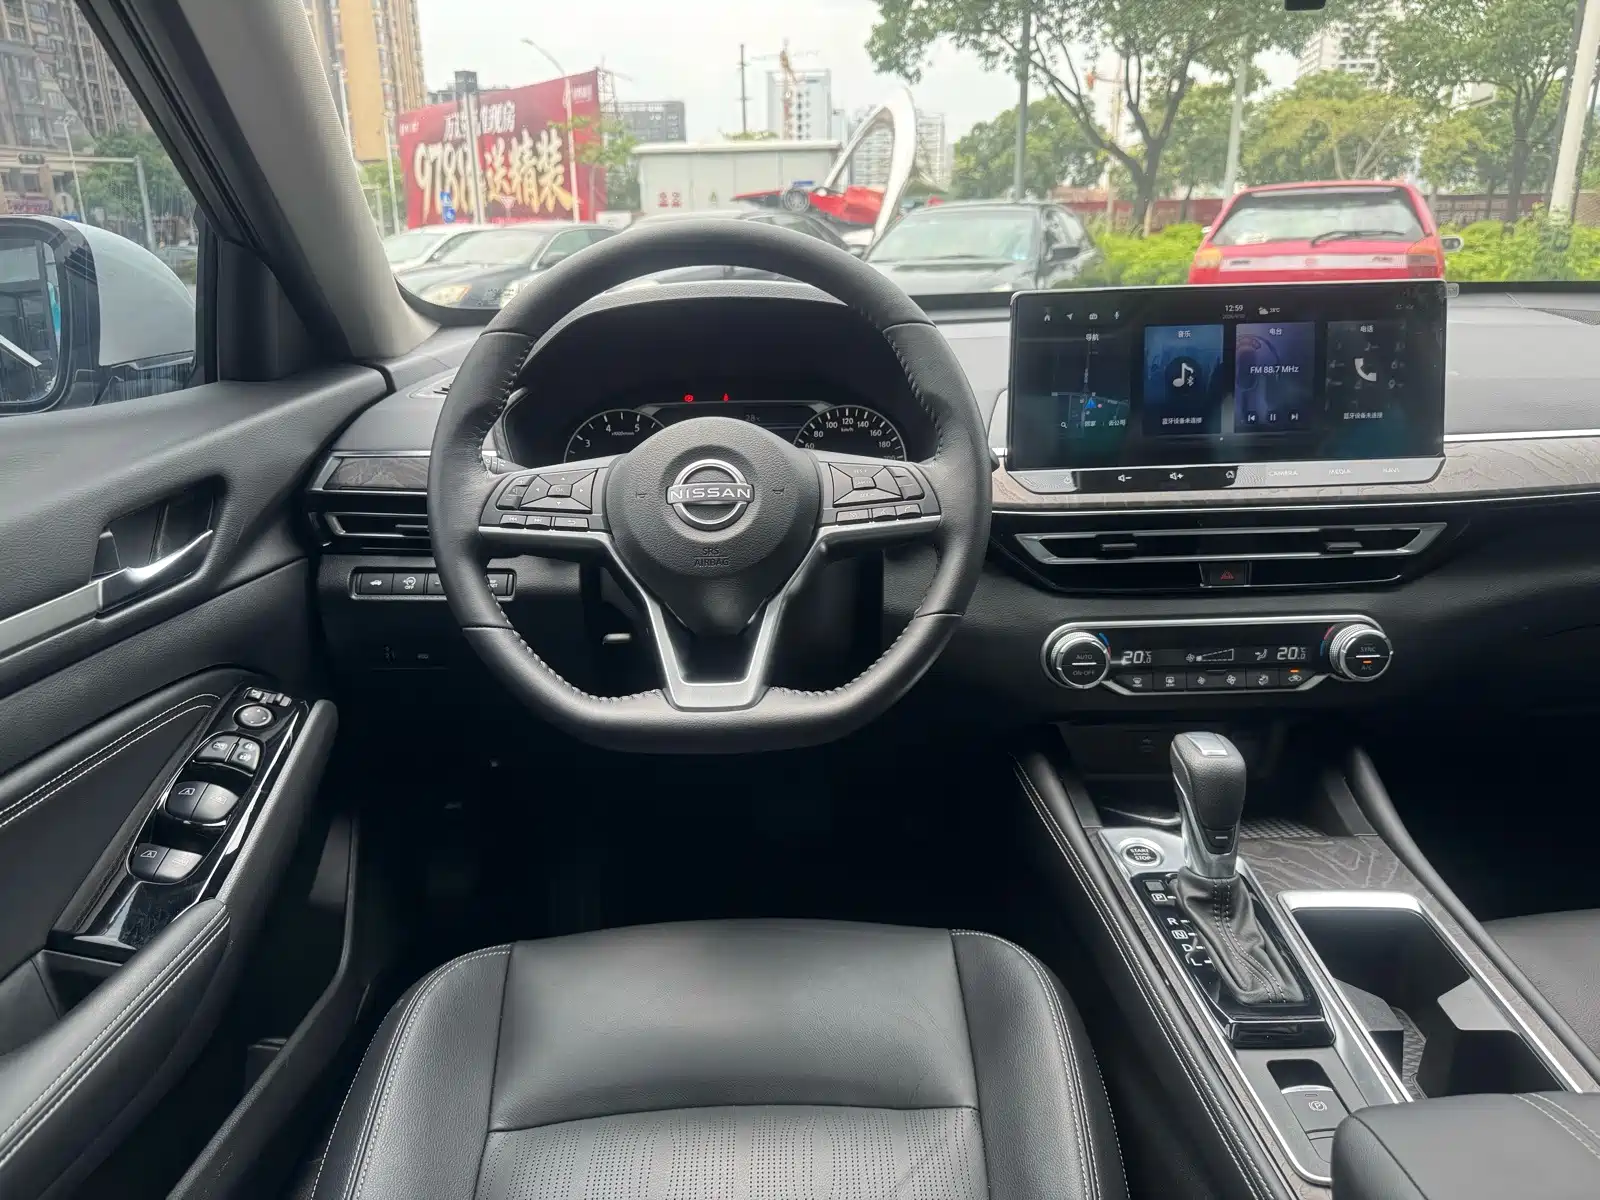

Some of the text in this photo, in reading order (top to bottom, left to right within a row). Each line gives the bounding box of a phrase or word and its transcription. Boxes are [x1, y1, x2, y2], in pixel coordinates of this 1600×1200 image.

[1224, 304, 1244, 312] 12:59
[1177, 330, 1192, 339] 音乐
[1269, 327, 1283, 336] 电台
[1250, 365, 1299, 374] FM 88.7 MHz
[825, 421, 838, 429] 100
[842, 417, 854, 425] 120
[857, 420, 869, 428] 140
[605, 424, 612, 433] 4
[634, 424, 640, 432] 5
[813, 430, 824, 438] 80
[870, 429, 882, 437] 160
[584, 439, 591, 448] 3
[670, 487, 751, 501] NISSAN
[702, 547, 720, 556] SRS
[694, 559, 730, 567] AIRBAG
[1075, 653, 1093, 661] AUTO
[1167, 917, 1178, 925] R
[1181, 943, 1193, 952] D
